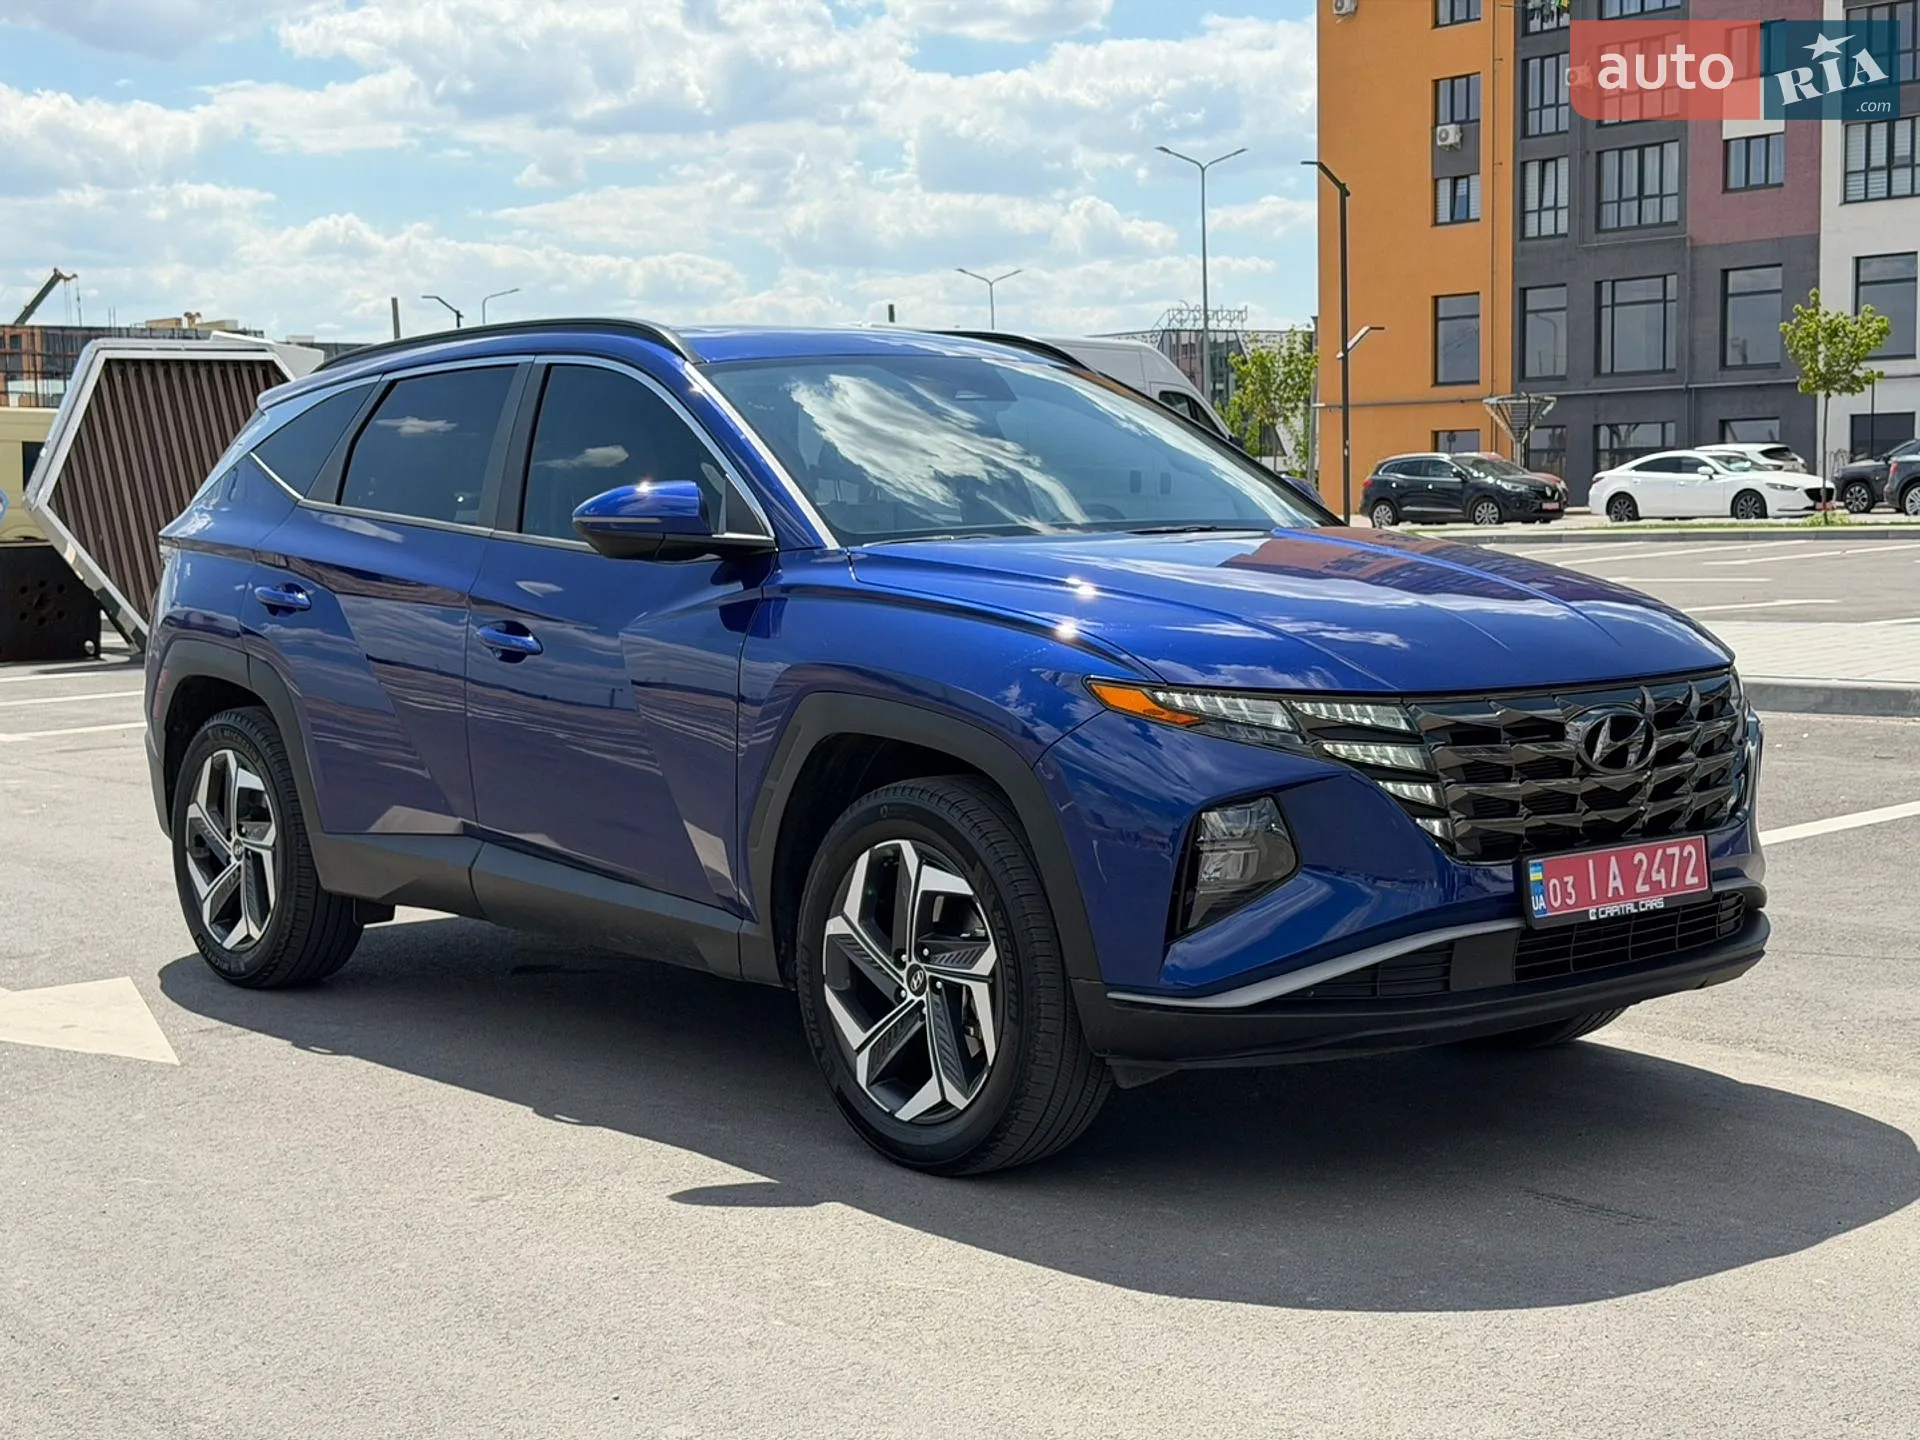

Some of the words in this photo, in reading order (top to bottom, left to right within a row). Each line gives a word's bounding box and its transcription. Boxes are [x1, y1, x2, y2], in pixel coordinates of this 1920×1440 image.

[1549, 875, 1577, 908] 03
[1633, 844, 1699, 894] 2472
[1531, 895, 1547, 911] UA
[1598, 902, 1638, 919] CAPITAL
[1639, 897, 1664, 912] CARS
